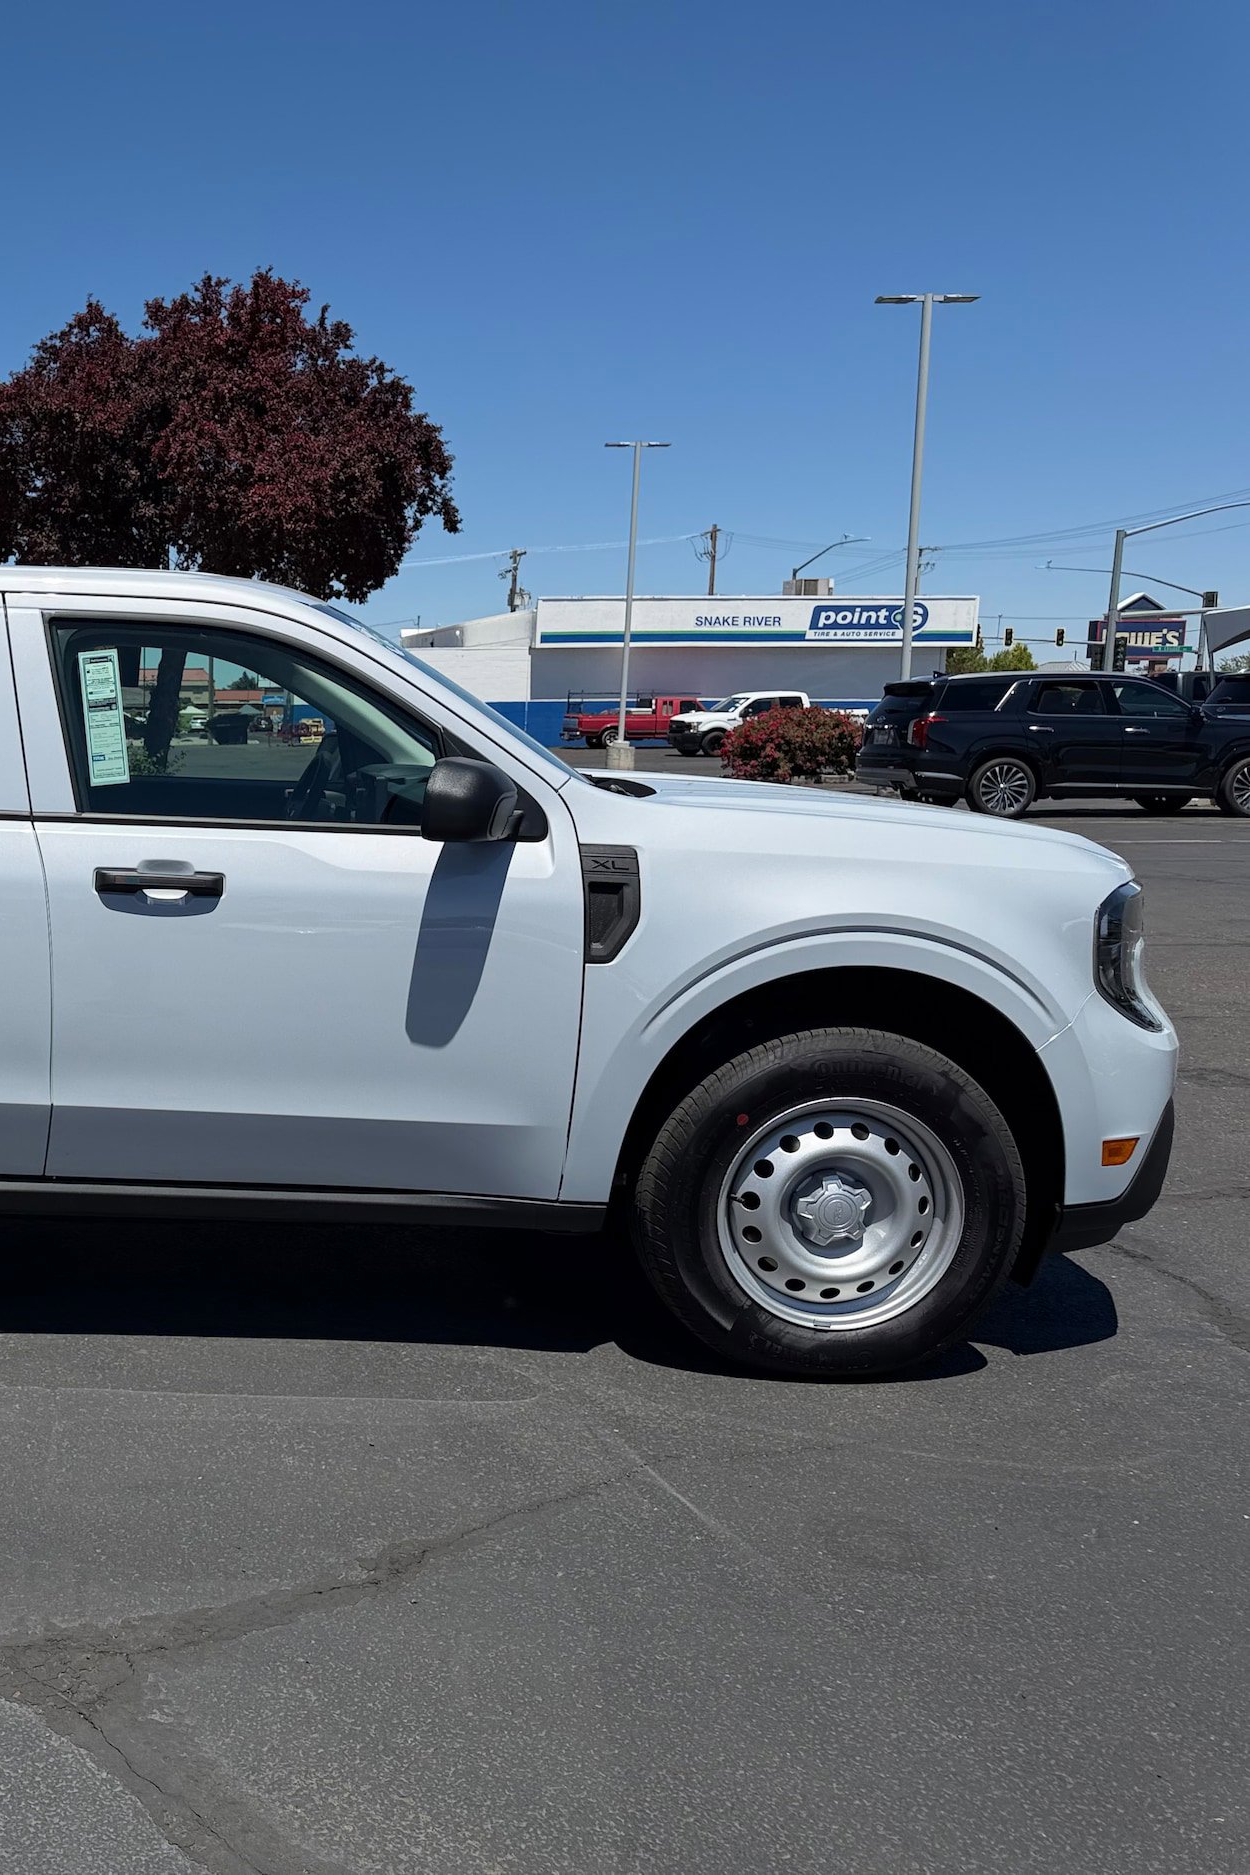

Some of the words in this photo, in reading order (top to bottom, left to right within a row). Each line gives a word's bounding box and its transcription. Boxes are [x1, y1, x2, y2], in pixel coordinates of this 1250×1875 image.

[695, 616, 740, 627] SNAKE
[743, 616, 781, 628] RIVER
[818, 607, 889, 629] point
[591, 859, 629, 870] XL
